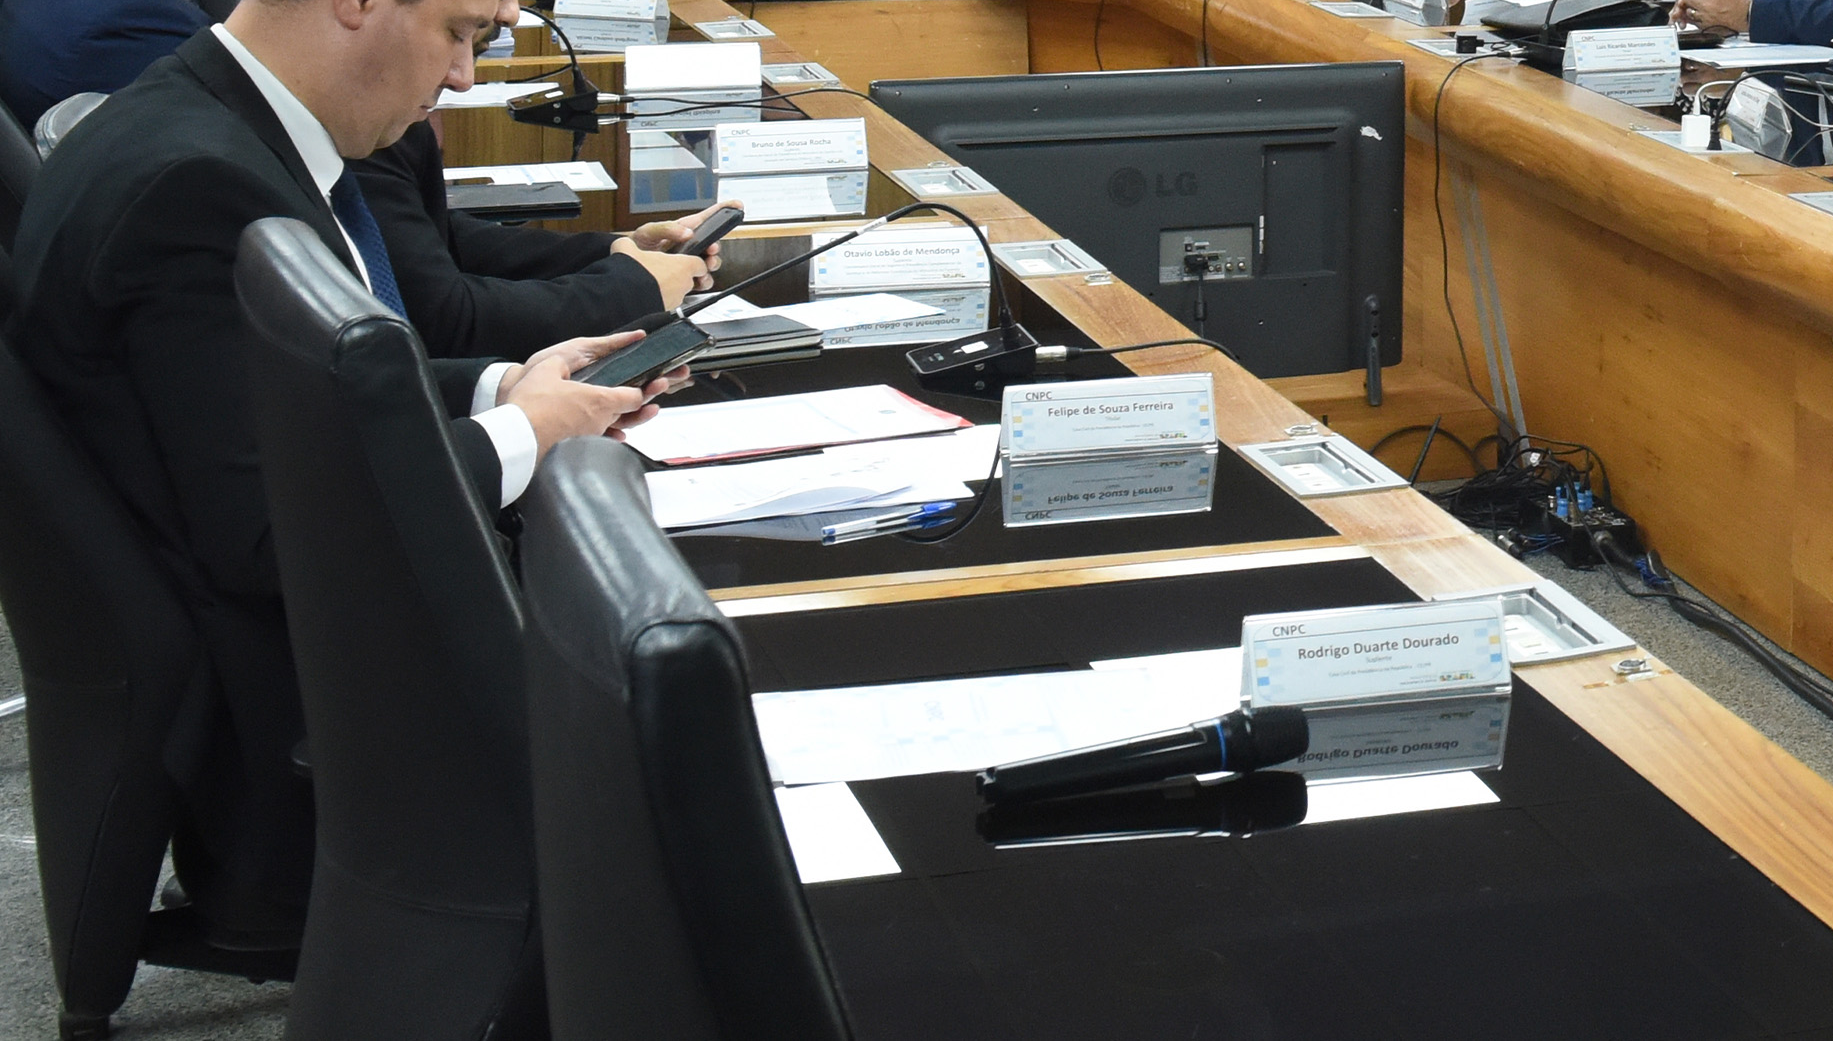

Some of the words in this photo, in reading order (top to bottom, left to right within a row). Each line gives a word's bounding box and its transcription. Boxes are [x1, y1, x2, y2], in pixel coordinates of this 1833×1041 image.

[786, 139, 808, 147] Sousa
[1156, 171, 1199, 197] LG
[843, 249, 873, 258] Otavio
[875, 247, 900, 257] Lobão
[902, 248, 913, 256] de
[915, 246, 960, 257] Mendonça
[1025, 391, 1053, 402] CNPC
[1048, 406, 1080, 418] Felipe
[1083, 405, 1096, 416] de
[1099, 403, 1130, 415] Souza
[1133, 400, 1174, 412] Ferreira
[1272, 624, 1306, 637] CNPC
[1298, 640, 1350, 660] Rodrigo
[1353, 639, 1399, 655] Duarte
[1402, 633, 1460, 650] Dourado
